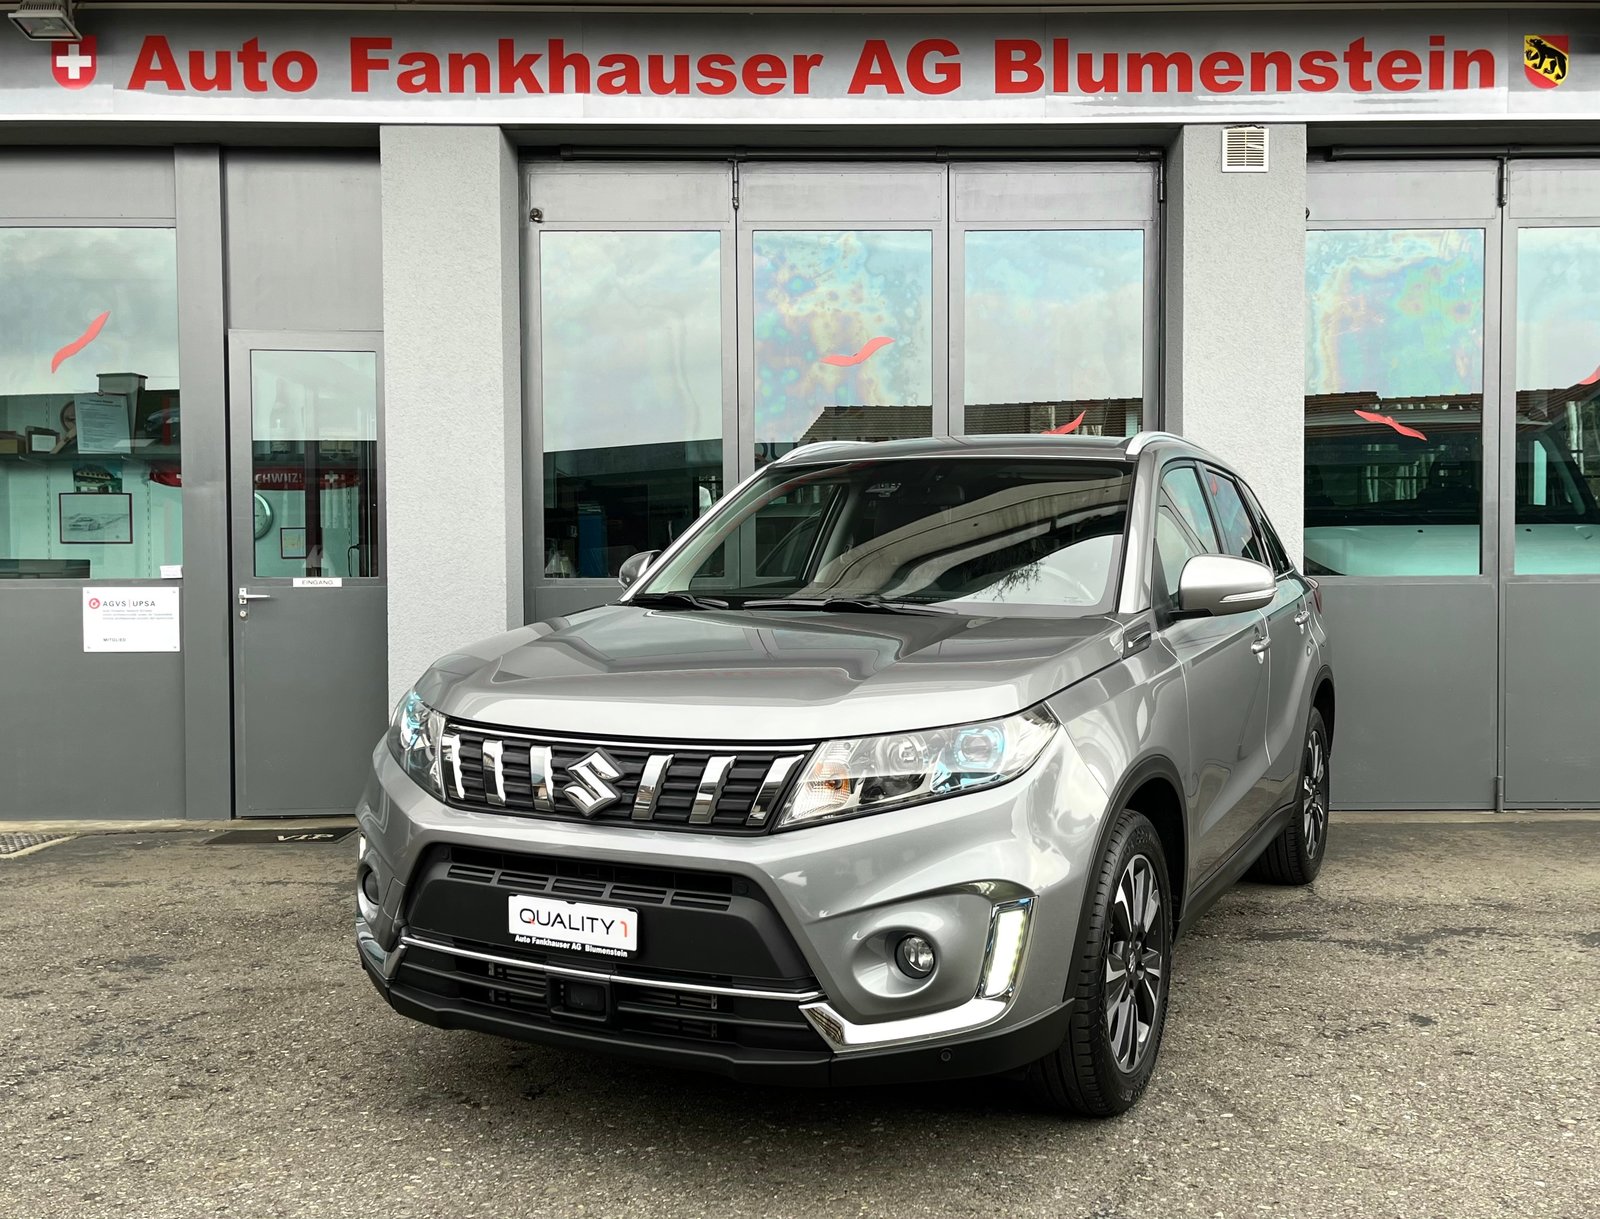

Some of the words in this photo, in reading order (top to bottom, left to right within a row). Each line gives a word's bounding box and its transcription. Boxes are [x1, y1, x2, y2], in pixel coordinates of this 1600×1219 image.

[128, 35, 318, 93] Auto
[350, 37, 823, 95] Fankhauser
[848, 39, 961, 95] AG
[995, 35, 1495, 94] Blumenstein
[515, 935, 531, 943] Auto
[532, 938, 570, 949] Fankhauser
[571, 942, 582, 951] AG
[585, 944, 628, 957] Blumenstein
